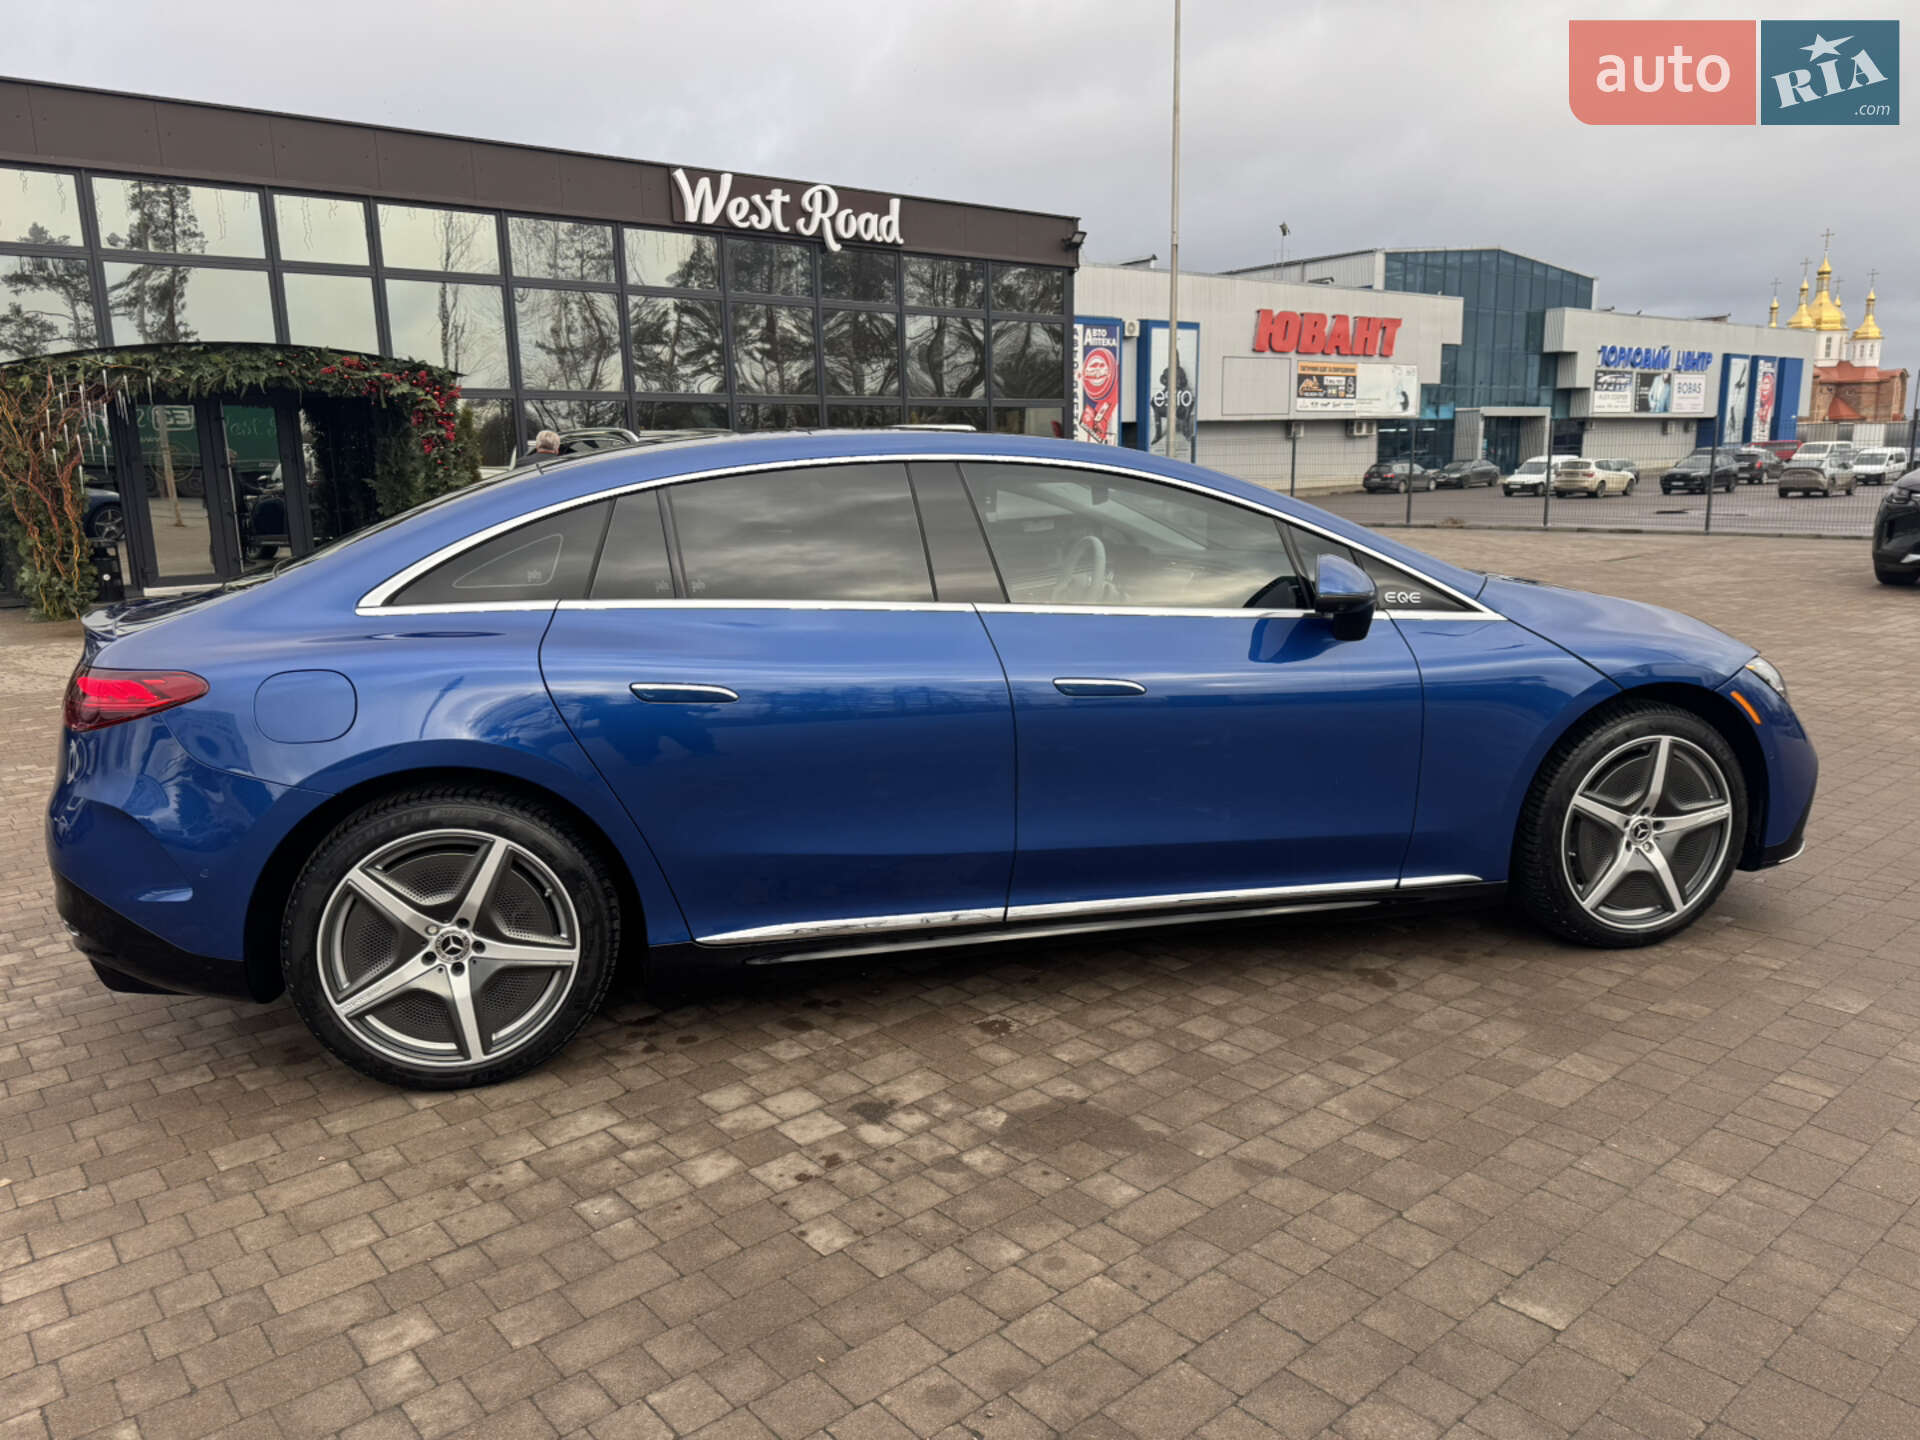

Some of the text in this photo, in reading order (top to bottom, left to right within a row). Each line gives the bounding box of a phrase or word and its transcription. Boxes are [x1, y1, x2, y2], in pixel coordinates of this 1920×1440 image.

[672, 168, 905, 251] West Road
[1252, 309, 1404, 358] ЮВАНТ
[1597, 345, 1714, 373] ТОРГОВИЙ ЦЕНТР
[1154, 390, 1193, 407] ero
[1384, 591, 1422, 604] EQE
